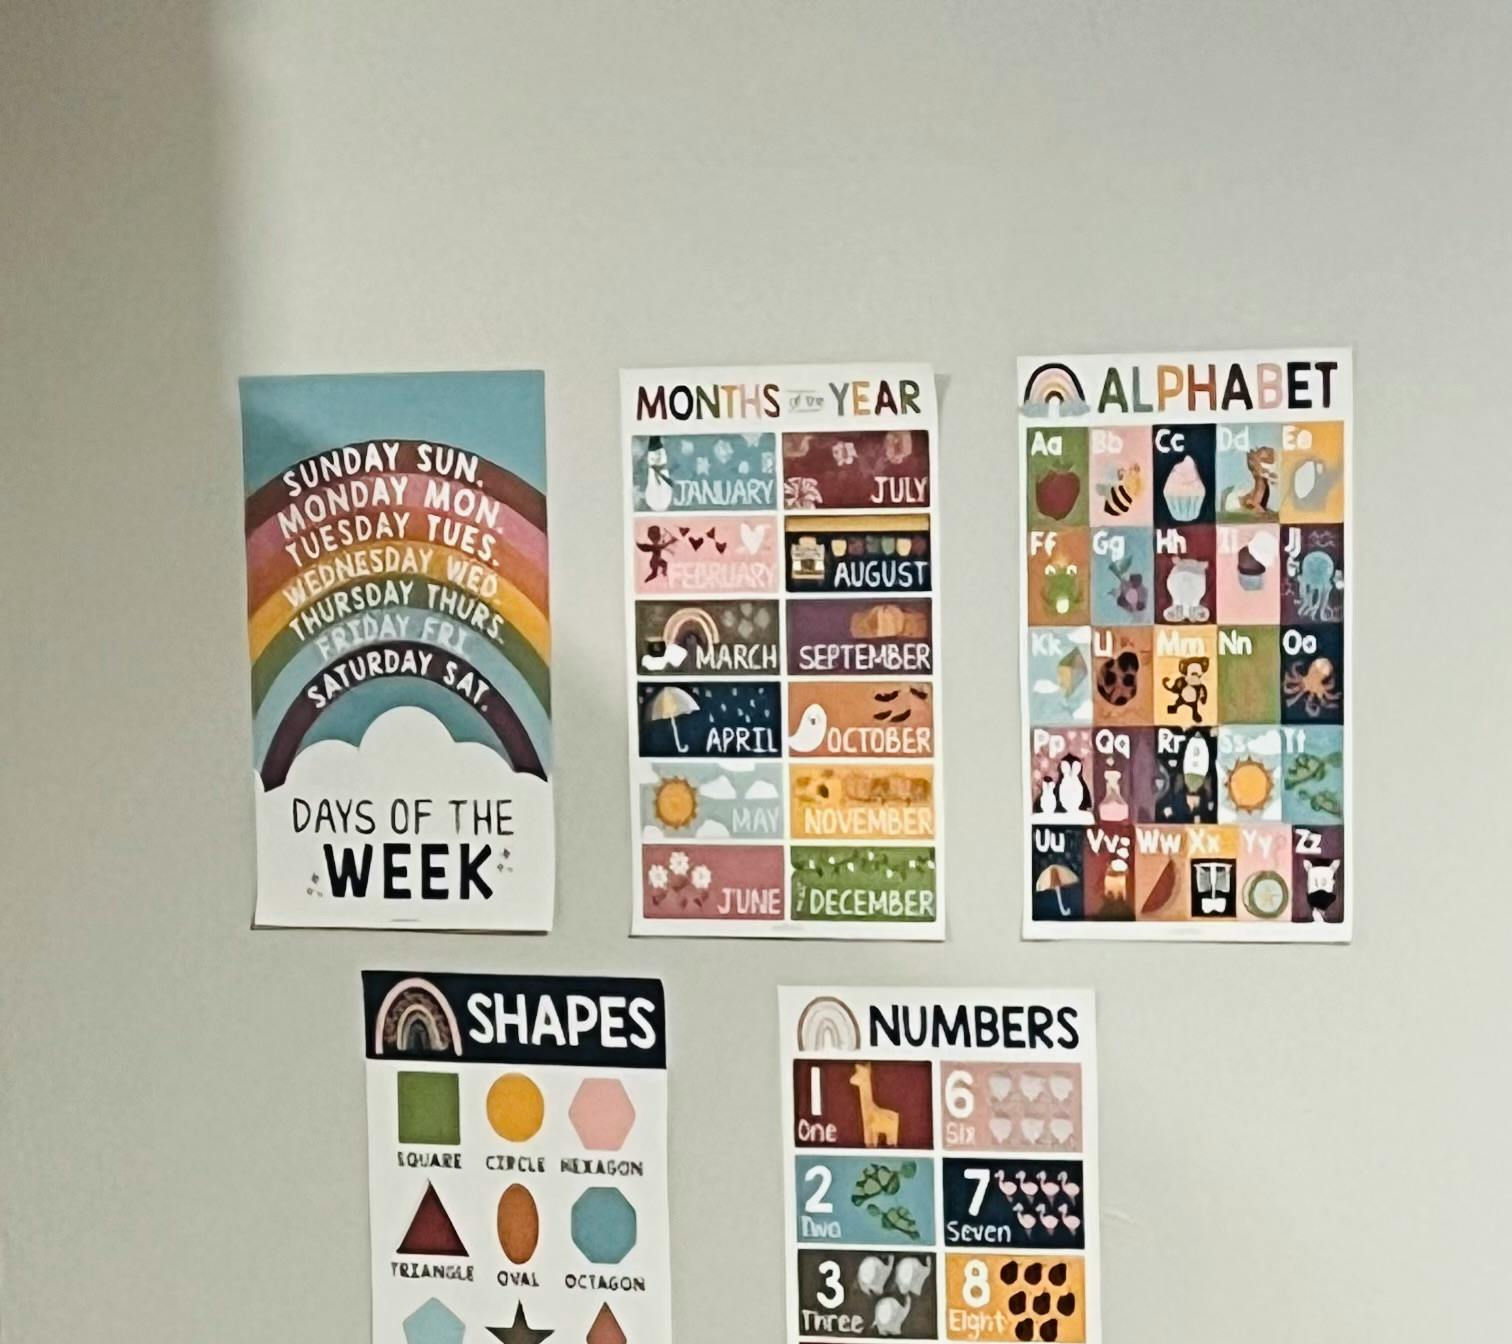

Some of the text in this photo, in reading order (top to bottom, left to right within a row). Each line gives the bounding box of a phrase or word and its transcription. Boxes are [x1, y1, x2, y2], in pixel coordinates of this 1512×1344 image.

[637, 383, 780, 421] MONTHS
[828, 379, 921, 418] YEAR
[1097, 362, 1338, 413] ALPHABET
[1031, 430, 1063, 456] Aa
[1092, 428, 1123, 456] Bb
[1155, 429, 1185, 453] Cc
[1218, 428, 1249, 453] Dd
[283, 441, 483, 498] SUNDAY SUN.
[673, 479, 774, 506] JANUARY
[871, 477, 928, 505] JULY
[277, 477, 502, 540] MONDAY MON.
[286, 512, 500, 567] TUESDAY TUES.
[1030, 531, 1057, 556] Ff
[1092, 531, 1125, 563] Gg
[1156, 530, 1186, 554] Hh
[1283, 528, 1301, 559] Jj
[283, 548, 433, 608] WEDNESDAY
[668, 560, 776, 591] FEBRUARY
[834, 560, 930, 588] AUGUST
[289, 582, 504, 643] THURSDAY THURS.
[317, 615, 409, 660] FRIDAY
[1031, 631, 1062, 658] Kk
[1156, 630, 1206, 657] Mm
[1219, 630, 1251, 654] Nn
[1282, 629, 1316, 654] Oo
[695, 644, 777, 671] MARCH
[799, 644, 931, 671] SEPTEMBER
[307, 652, 488, 712] SATURDAY SAT.
[705, 727, 779, 753] APRIL
[826, 726, 931, 754] OCTOBER
[1033, 730, 1065, 760] Pp
[1095, 730, 1131, 761] Qq
[1157, 731, 1186, 755] Rr
[1220, 729, 1247, 755] Ss
[293, 798, 514, 835] DAYS OF THE
[732, 807, 780, 831] MAY
[804, 807, 933, 836] NOVEMBER
[1034, 828, 1321, 858] Uu Vv Ww Xx Yy Zz
[324, 843, 495, 899] WEEK
[717, 888, 781, 915] JUNE
[809, 889, 934, 917] DECEMBER
[467, 992, 657, 1050] SHAPES
[869, 1005, 1080, 1050] NUMBERS
[810, 1067, 822, 1116] 1
[945, 1070, 973, 1119] 6
[798, 1119, 837, 1143] One
[397, 1151, 462, 1169] SQUARE
[486, 1156, 545, 1173] CIRCLE
[560, 1158, 643, 1176] HEXAGON
[803, 1165, 833, 1214] 2
[963, 1168, 991, 1216] 7
[947, 1218, 1012, 1243] Seven
[391, 1263, 474, 1282] TRIANGLE
[497, 1271, 540, 1288] OVAL
[565, 1274, 645, 1291] OCTAGON
[815, 1261, 844, 1309] 3
[962, 1259, 991, 1308] 8
[801, 1310, 864, 1334] Three
